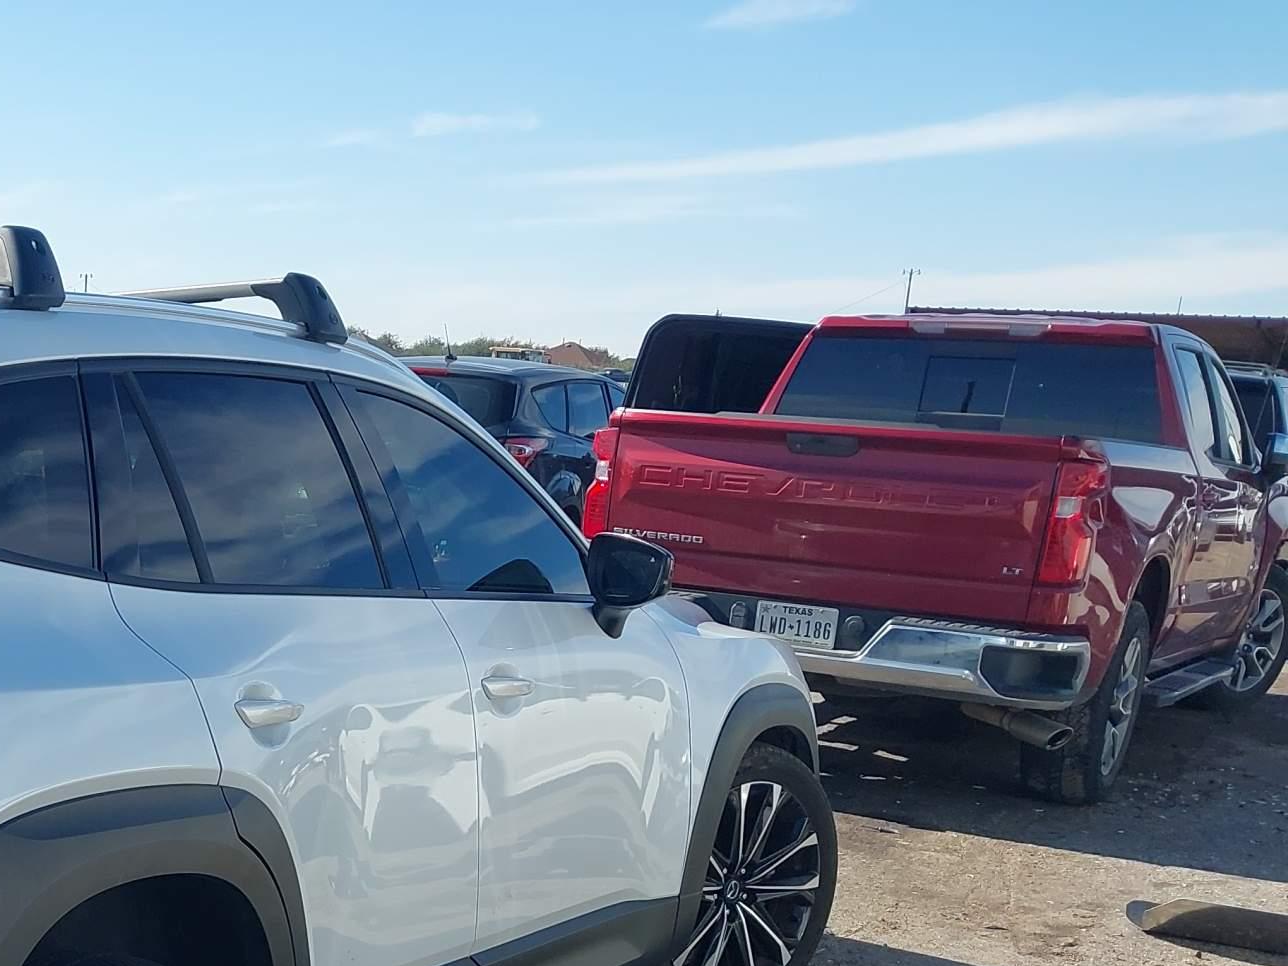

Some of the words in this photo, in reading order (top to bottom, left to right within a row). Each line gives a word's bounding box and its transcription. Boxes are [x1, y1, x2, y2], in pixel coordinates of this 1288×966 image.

[613, 526, 704, 544] SILVERADO
[1002, 566, 1024, 576] LT
[783, 606, 814, 617] TEXAS
